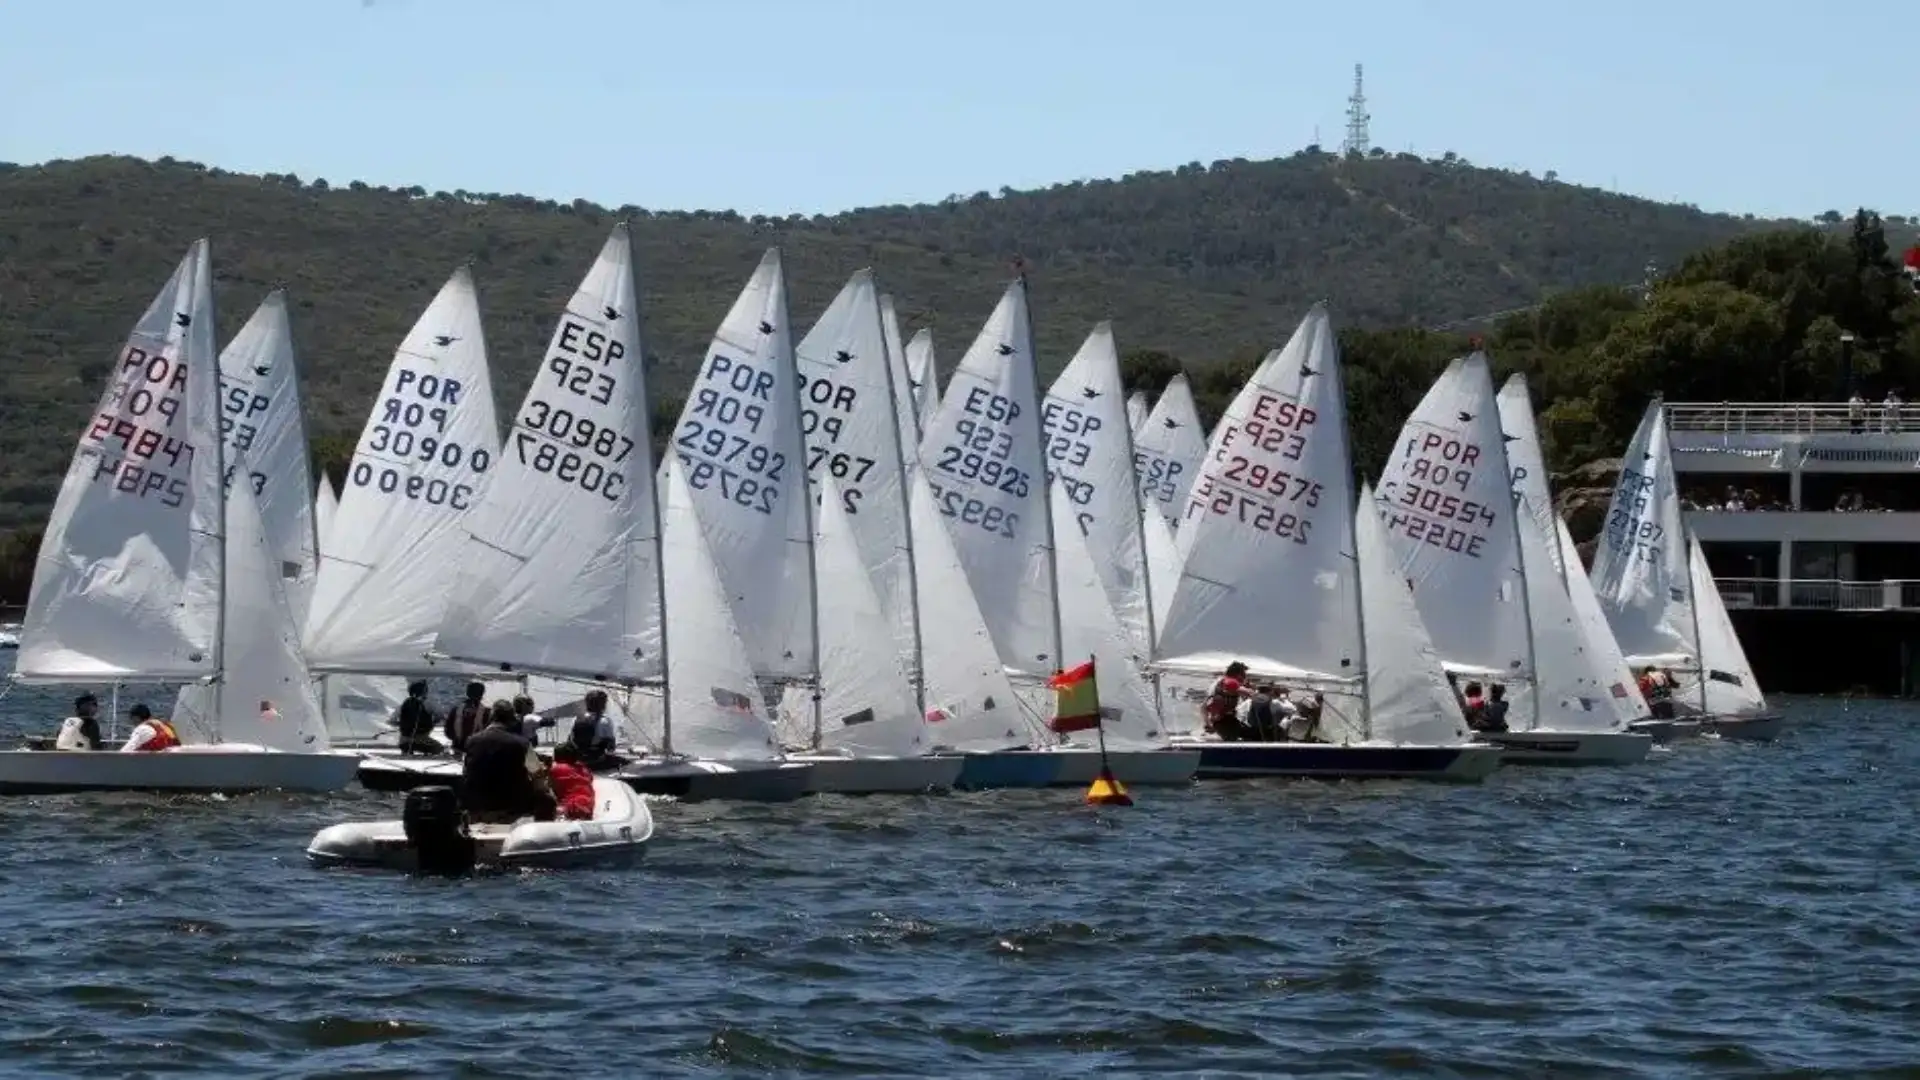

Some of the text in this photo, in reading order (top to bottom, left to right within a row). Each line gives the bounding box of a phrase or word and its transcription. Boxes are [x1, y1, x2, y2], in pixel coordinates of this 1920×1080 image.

[558, 321, 625, 367] ESP
[122, 347, 189, 393] POR
[395, 369, 462, 405] POR
[706, 354, 775, 402] POR
[220, 382, 270, 418] SP
[963, 386, 1022, 426] ESP
[1043, 402, 1102, 437] ESP
[1252, 394, 1318, 432] ESP
[88, 413, 196, 474] 29847
[369, 425, 491, 474] 30900
[524, 400, 636, 464] 30987
[677, 420, 786, 483] 29792
[1422, 432, 1481, 468] POR
[808, 446, 876, 483] 767
[936, 446, 1031, 499] 29925
[1134, 452, 1184, 481] ESP
[1223, 455, 1326, 509] 29575
